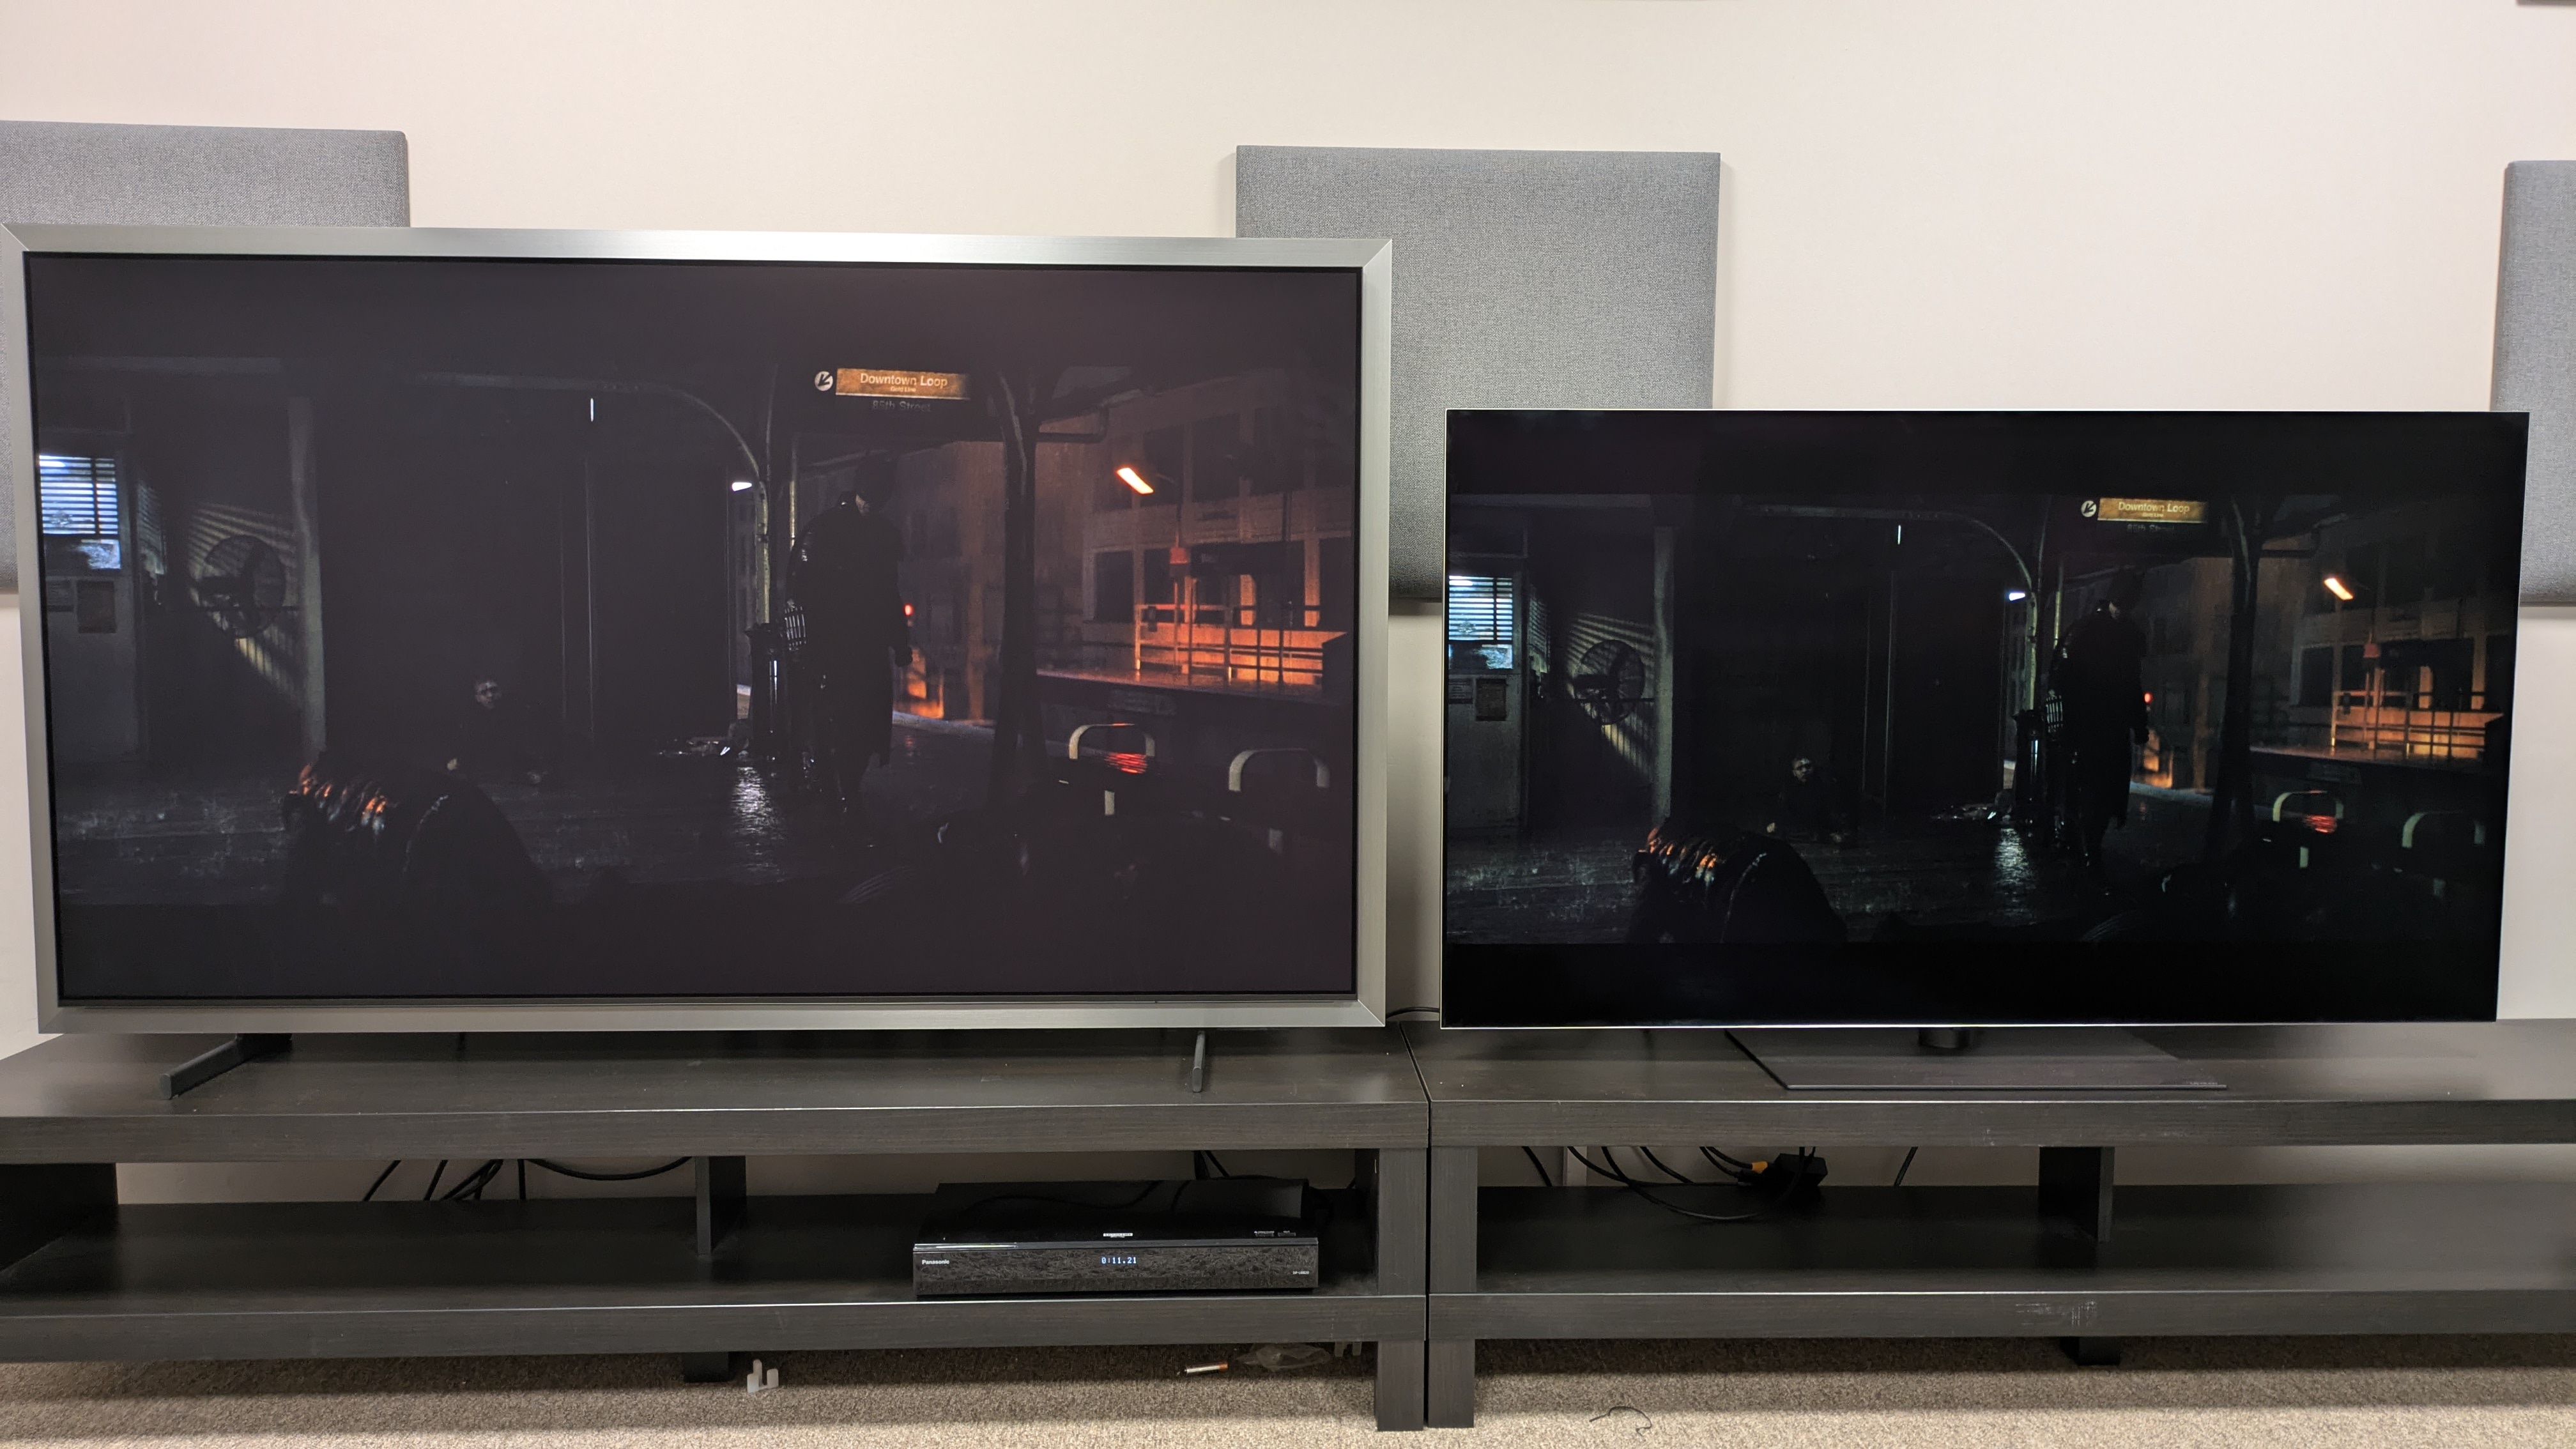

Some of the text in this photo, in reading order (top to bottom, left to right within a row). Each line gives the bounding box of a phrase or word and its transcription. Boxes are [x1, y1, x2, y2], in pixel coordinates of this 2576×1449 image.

[860, 373, 947, 389] Downtown Loop
[2119, 502, 2189, 514] Downtown Loop
